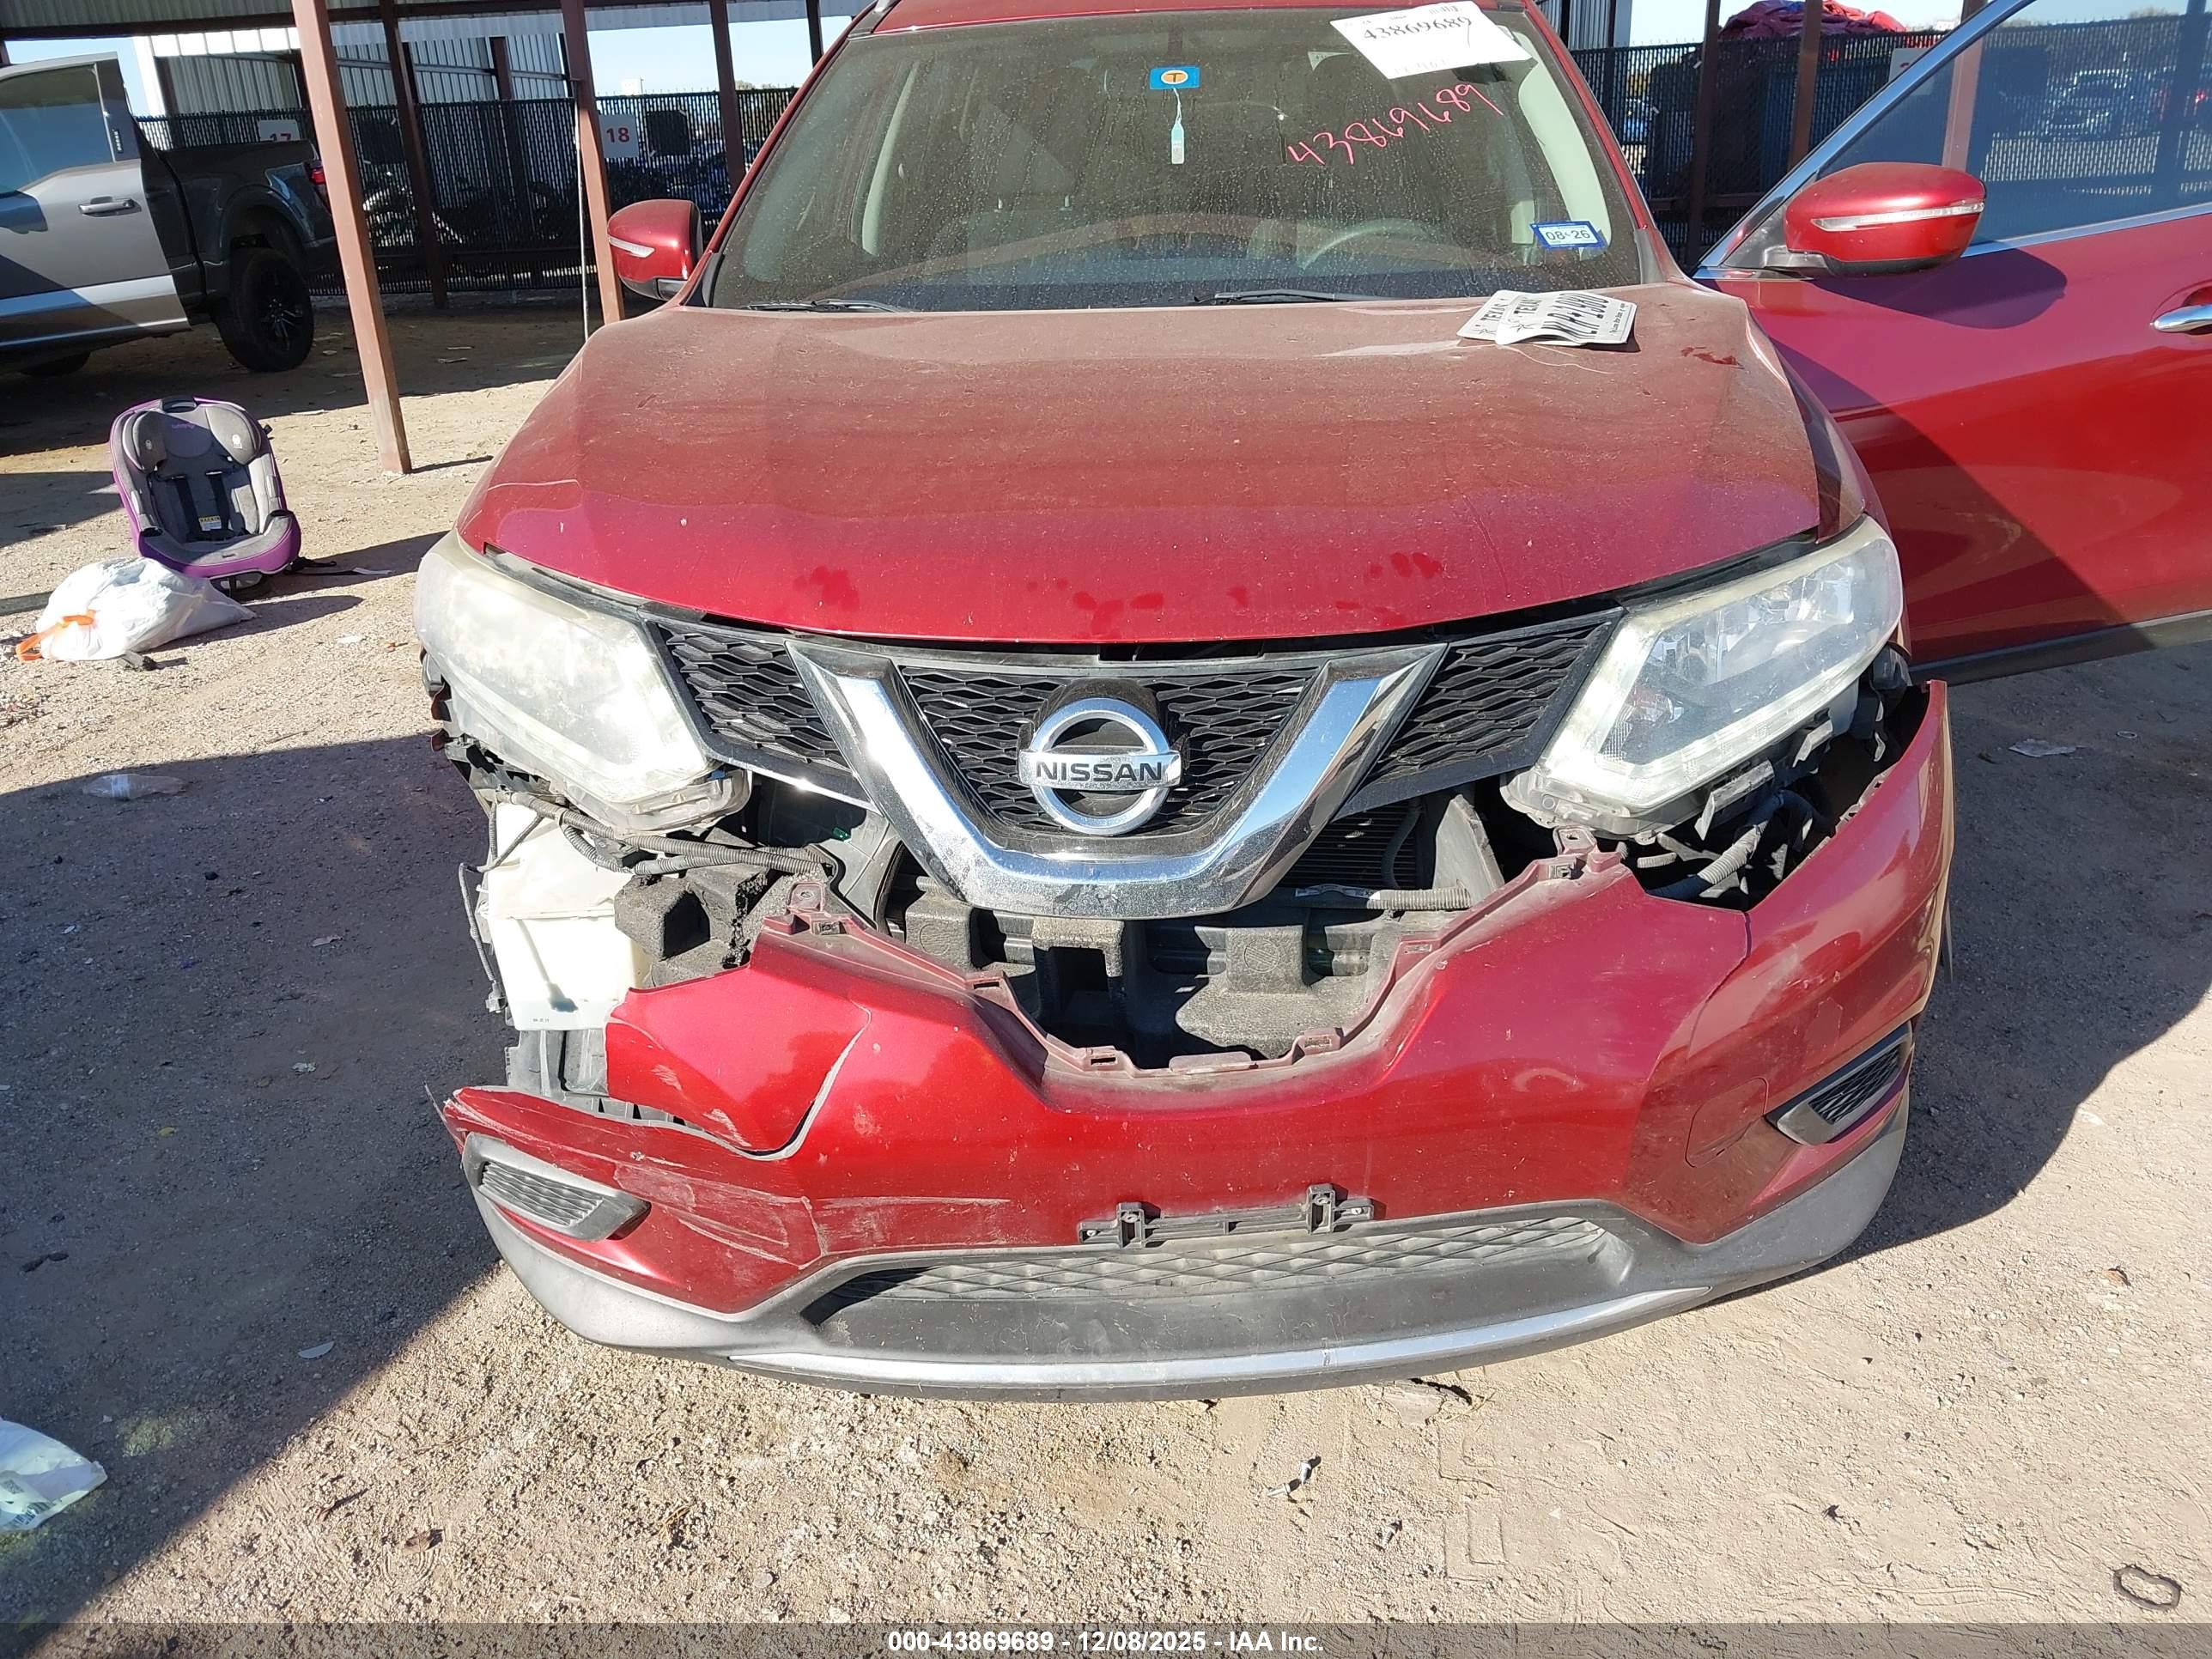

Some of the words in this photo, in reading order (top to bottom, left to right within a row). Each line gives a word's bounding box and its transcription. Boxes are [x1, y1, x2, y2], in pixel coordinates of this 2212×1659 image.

[1364, 15, 1472, 45] 43869689
[1288, 83, 1504, 165] 43869689
[606, 127, 629, 143] 18
[1546, 230, 1565, 240] 08
[1571, 230, 1591, 240] 26
[1480, 302, 1509, 322] TEXAS
[1036, 762, 1162, 782] NISSAN
